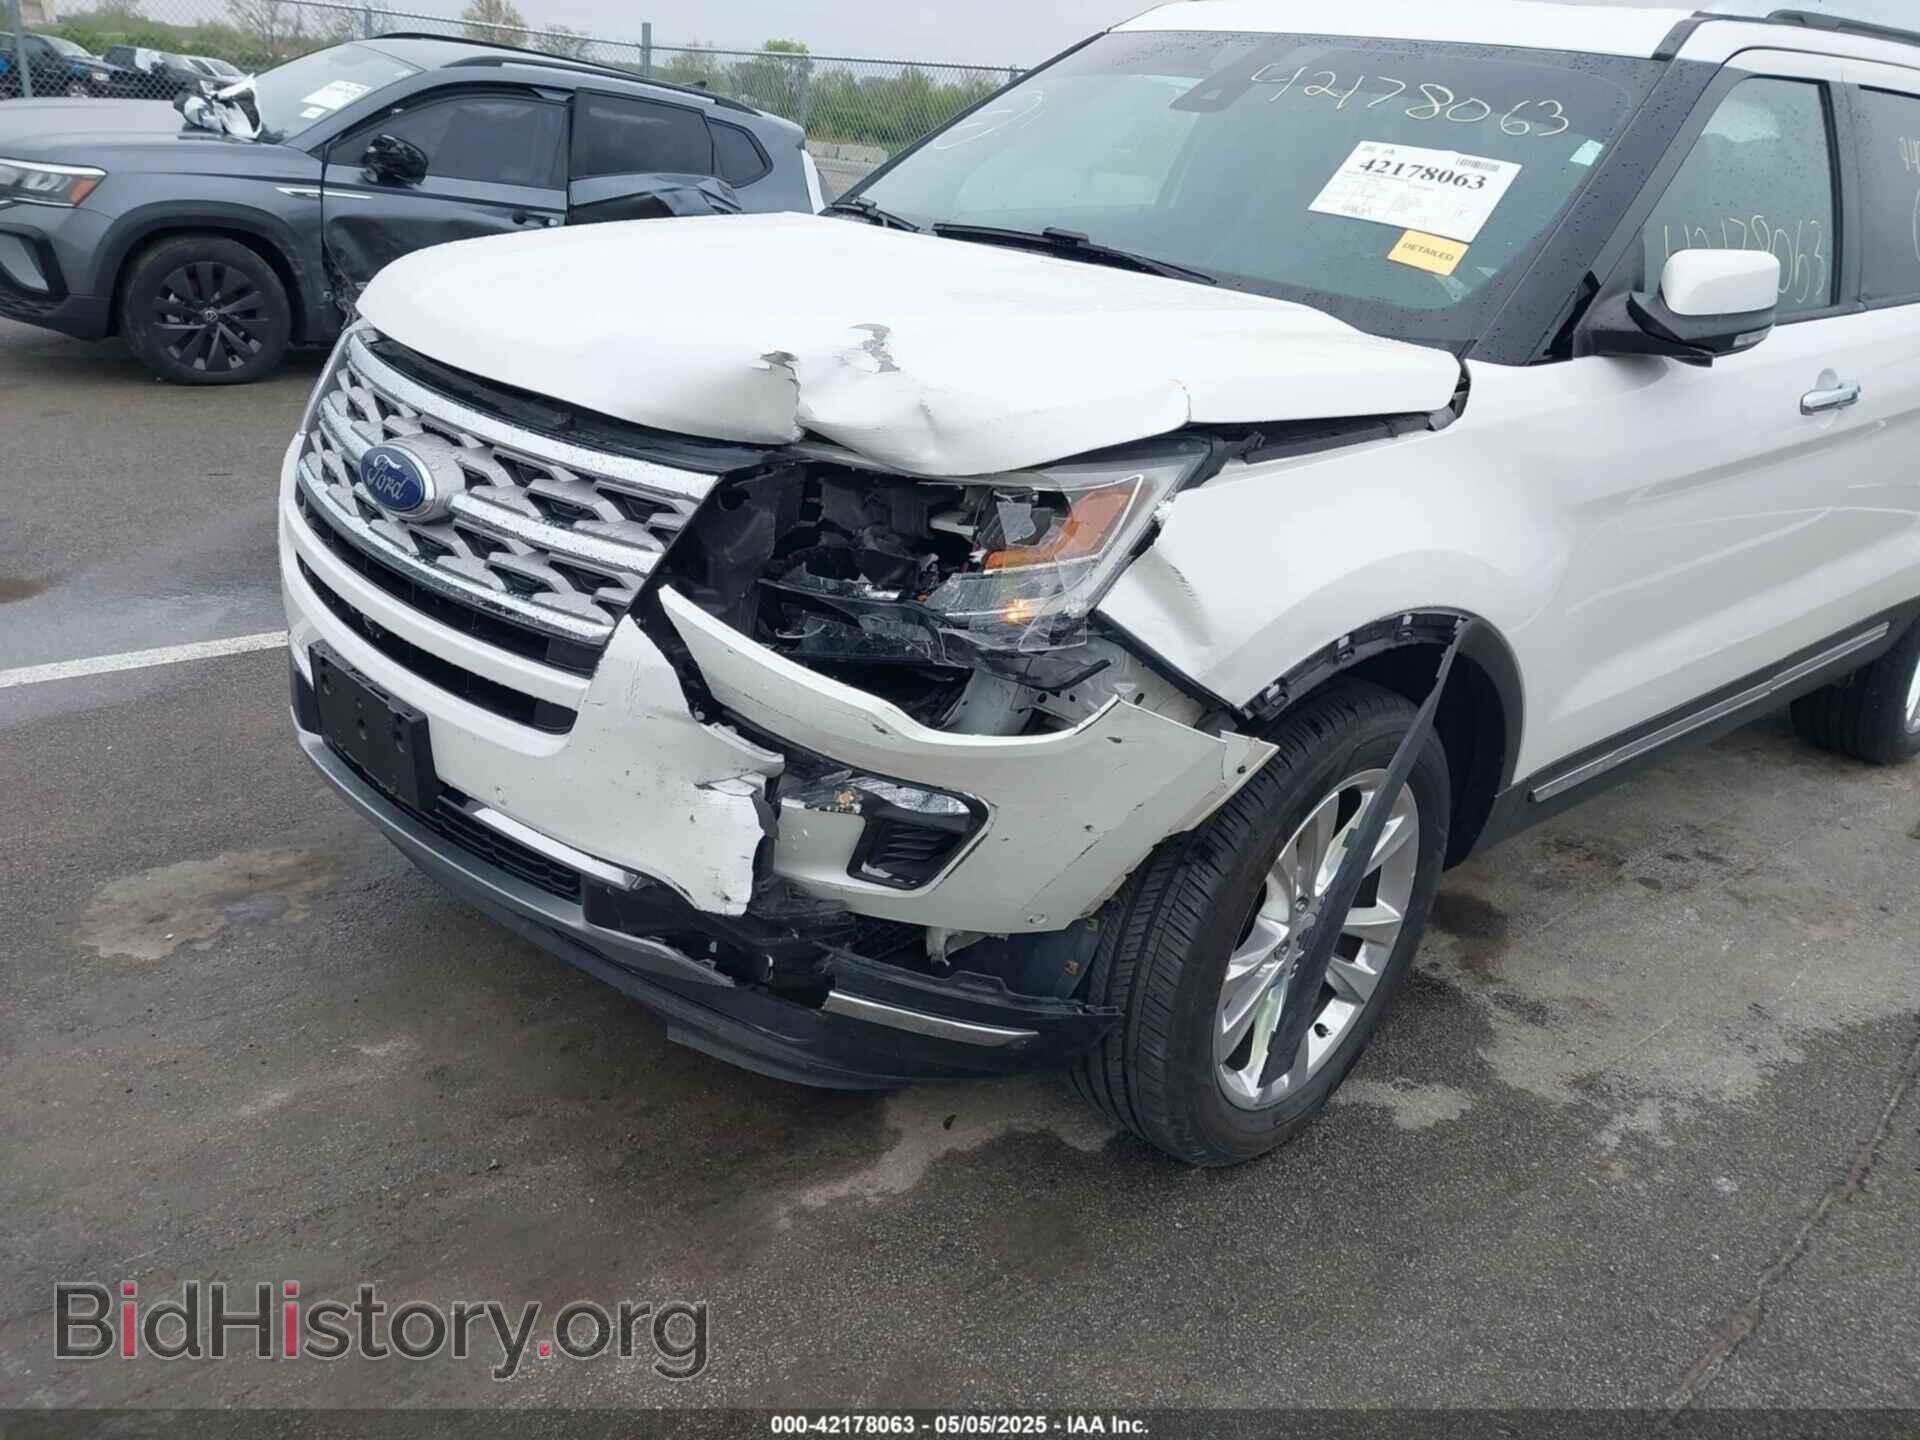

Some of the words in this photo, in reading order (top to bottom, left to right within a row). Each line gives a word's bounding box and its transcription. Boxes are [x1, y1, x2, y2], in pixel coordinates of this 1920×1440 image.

[1250, 63, 1570, 136] 42178063
[1359, 158, 1488, 190] 42178063
[1402, 241, 1455, 262] DETAILED
[366, 453, 409, 500] Ford
